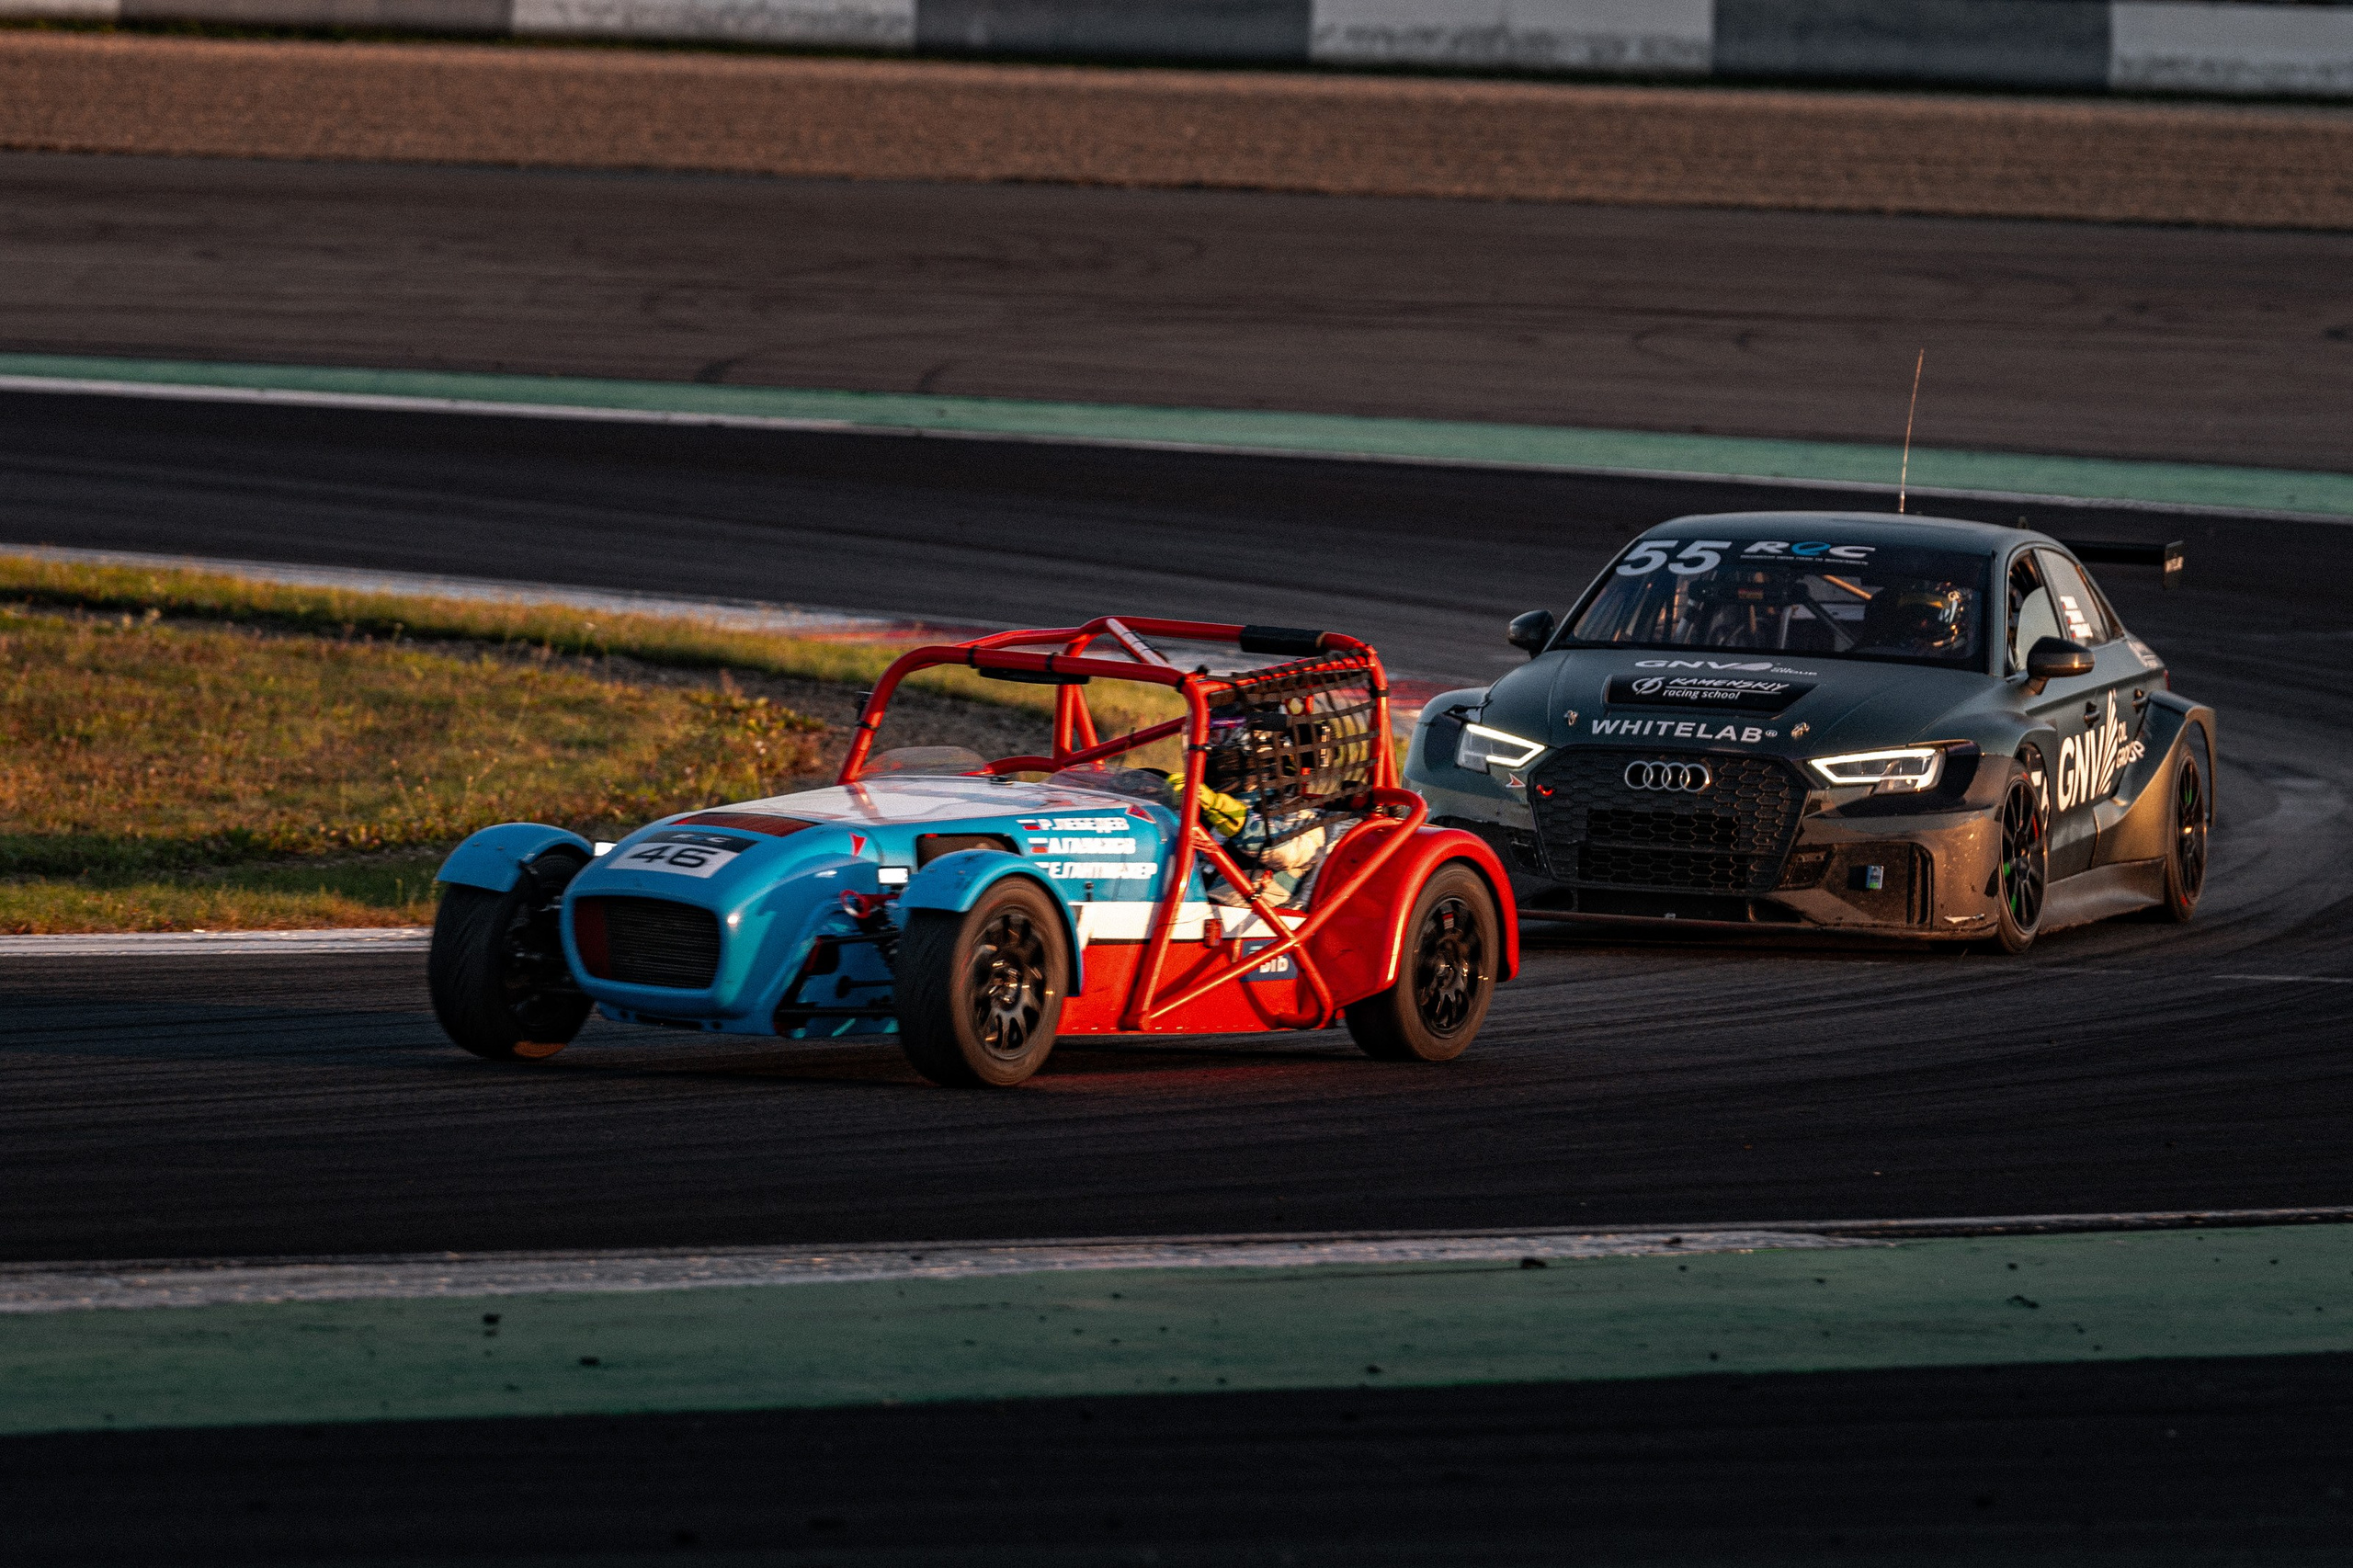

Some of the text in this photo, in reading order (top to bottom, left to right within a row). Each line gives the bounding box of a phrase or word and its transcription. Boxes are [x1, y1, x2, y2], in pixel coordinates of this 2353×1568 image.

[1616, 540, 1733, 576] 55
[1662, 688, 1741, 700] racing school
[1669, 676, 1790, 692] KAMENSKIY
[2057, 724, 2107, 812] GNV
[627, 845, 720, 869] 46
